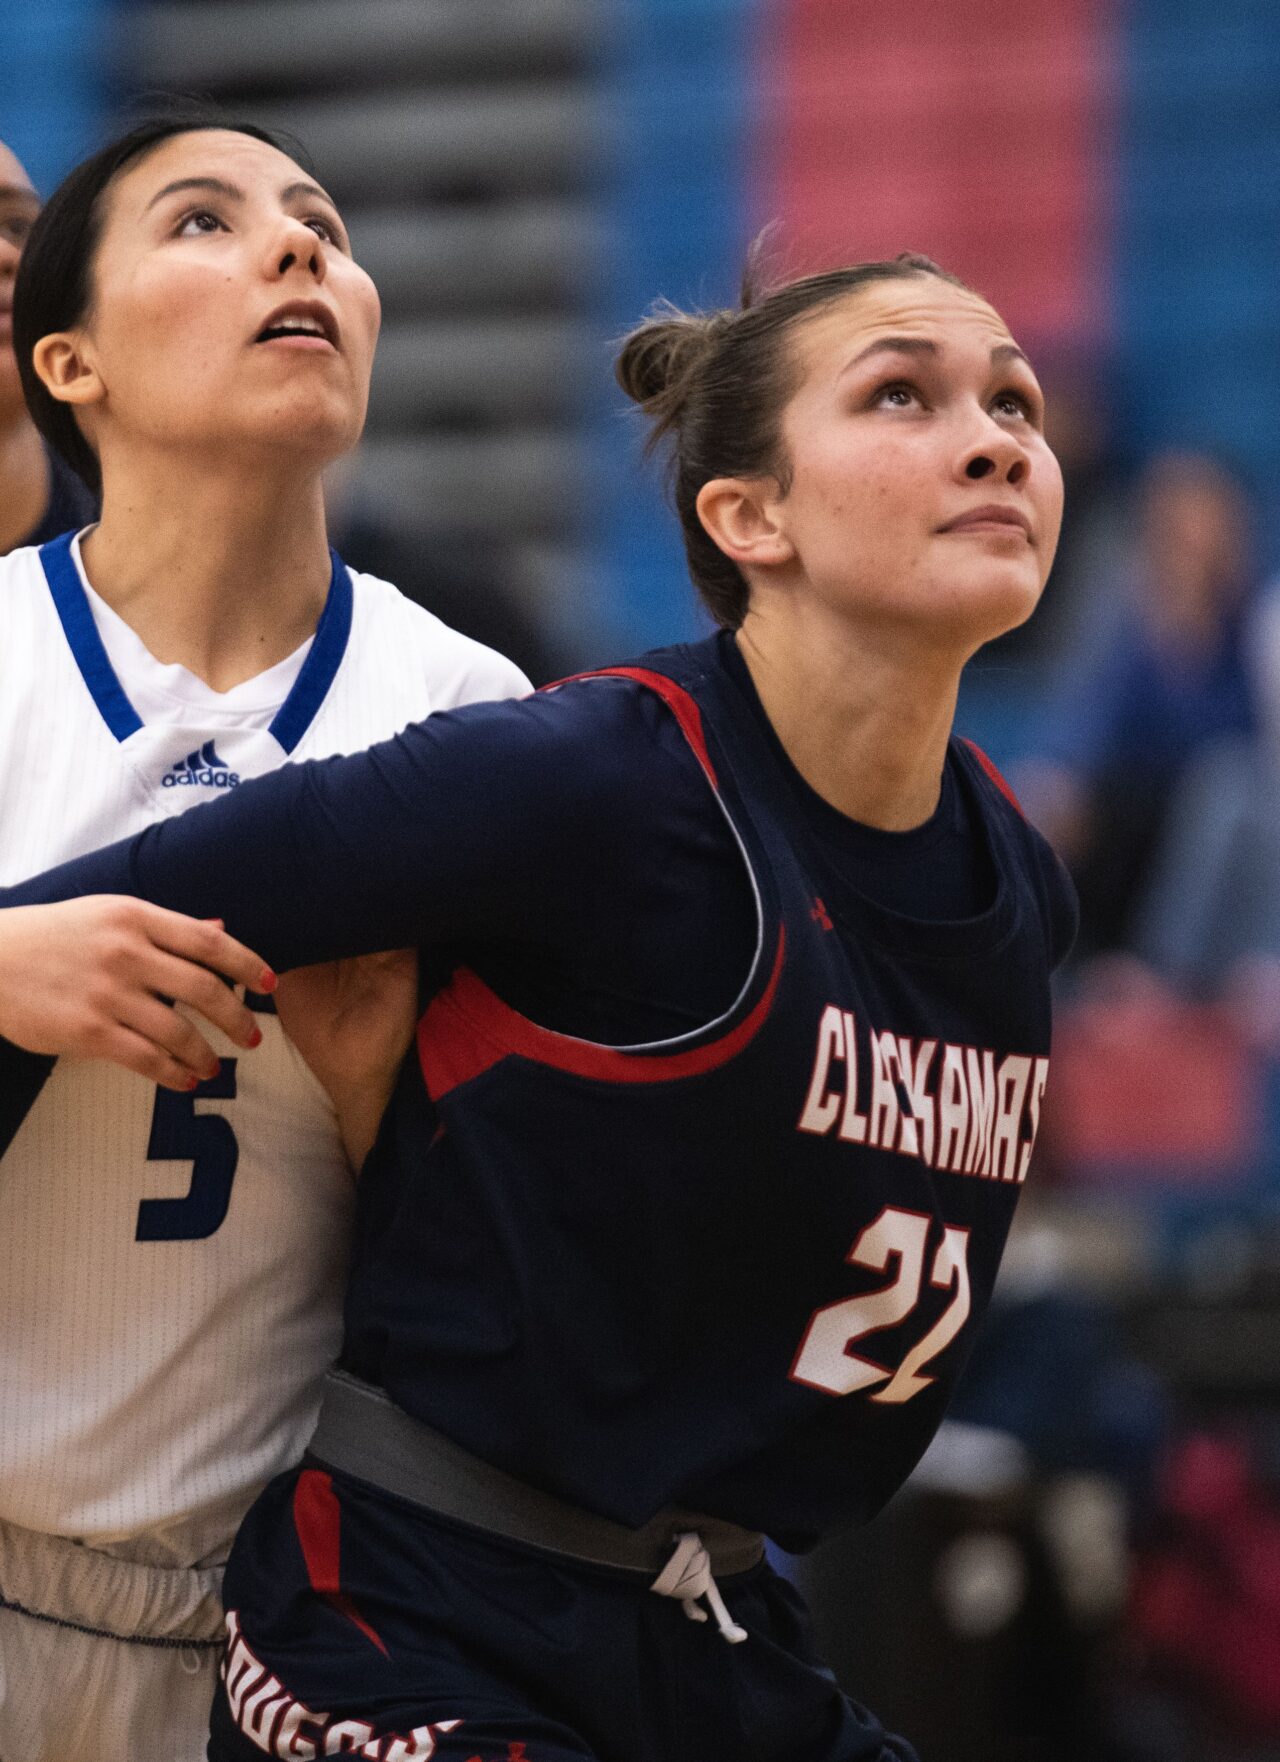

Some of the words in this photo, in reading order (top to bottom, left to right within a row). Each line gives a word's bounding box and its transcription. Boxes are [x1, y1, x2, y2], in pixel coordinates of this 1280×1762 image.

[161, 768, 241, 788] adidas
[135, 1056, 239, 1242] 5
[787, 1203, 971, 1405] 22
